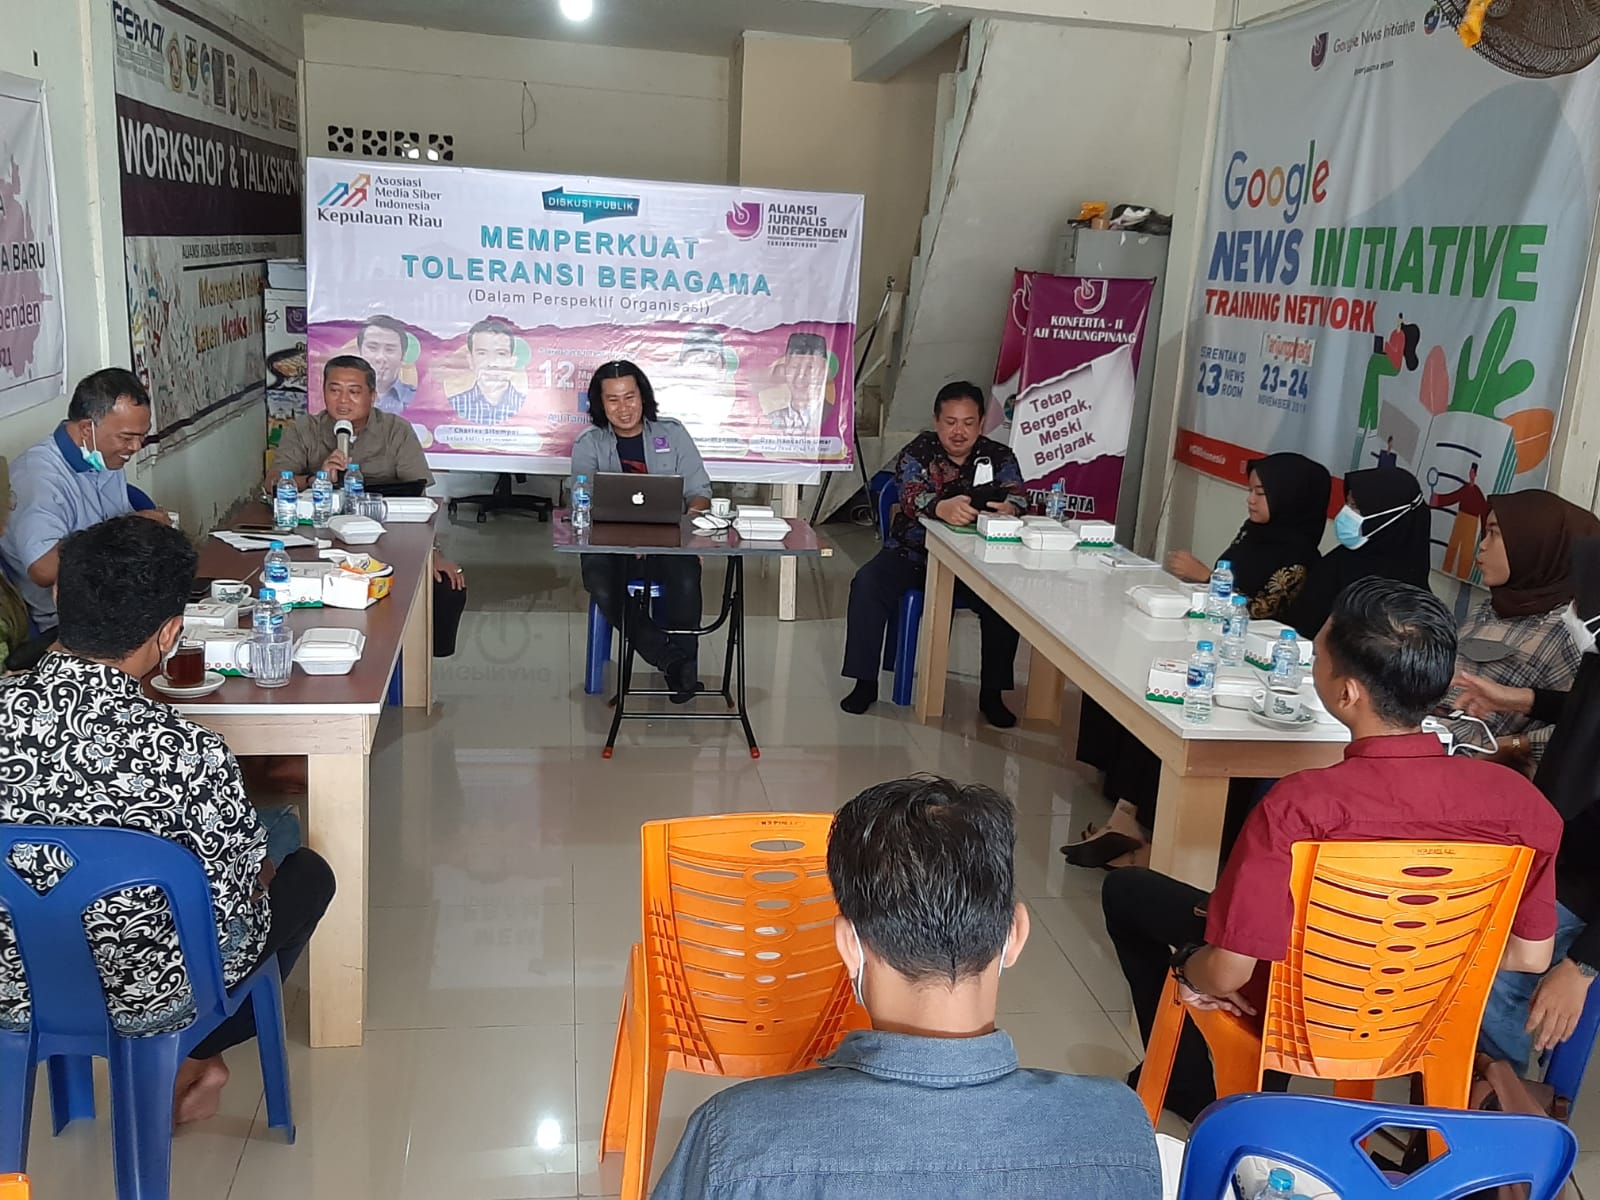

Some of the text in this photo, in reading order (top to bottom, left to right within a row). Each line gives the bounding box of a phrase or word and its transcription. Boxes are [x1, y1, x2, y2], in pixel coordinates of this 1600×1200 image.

[1383, 20, 1416, 39] Initiative
[120, 115, 225, 187] WORKSHOP
[229, 145, 239, 189] &
[374, 187, 442, 201] Media Siber
[375, 175, 422, 188] Asosiasi
[1224, 140, 1329, 223] Google
[374, 198, 430, 211] Indonesia
[548, 197, 634, 212] DISKUSI PUBLIK
[768, 203, 817, 216] ALIANSI
[317, 208, 443, 228] Kepulauan Riau
[768, 214, 827, 227] JURNALIS
[481, 225, 698, 260] MEMPERKUAT
[768, 225, 848, 239] INDEPENDEN
[13, 241, 46, 271] BARU
[1208, 224, 1548, 302] NEWS INITIATIVE
[401, 255, 772, 297] TOLERANSI BERAGAMA
[468, 289, 711, 315] (Dalam Perspektif Organisasi)
[1205, 288, 1377, 334] TRAINING NETWORK
[1051, 315, 1105, 329] KONFERTA
[1033, 327, 1137, 344] AJI TANJUNGPINANG
[538, 359, 575, 388] 12
[1197, 361, 1222, 396] 23
[1224, 368, 1245, 384] NEWS
[1260, 363, 1309, 399] 23-24
[1029, 388, 1072, 413] Tetap
[1221, 383, 1244, 398] ROOM
[1020, 400, 1092, 435] Bergerak,
[1038, 417, 1083, 446] Meski
[1034, 431, 1096, 466] Berjarak
[1028, 489, 1094, 513] KORTA
